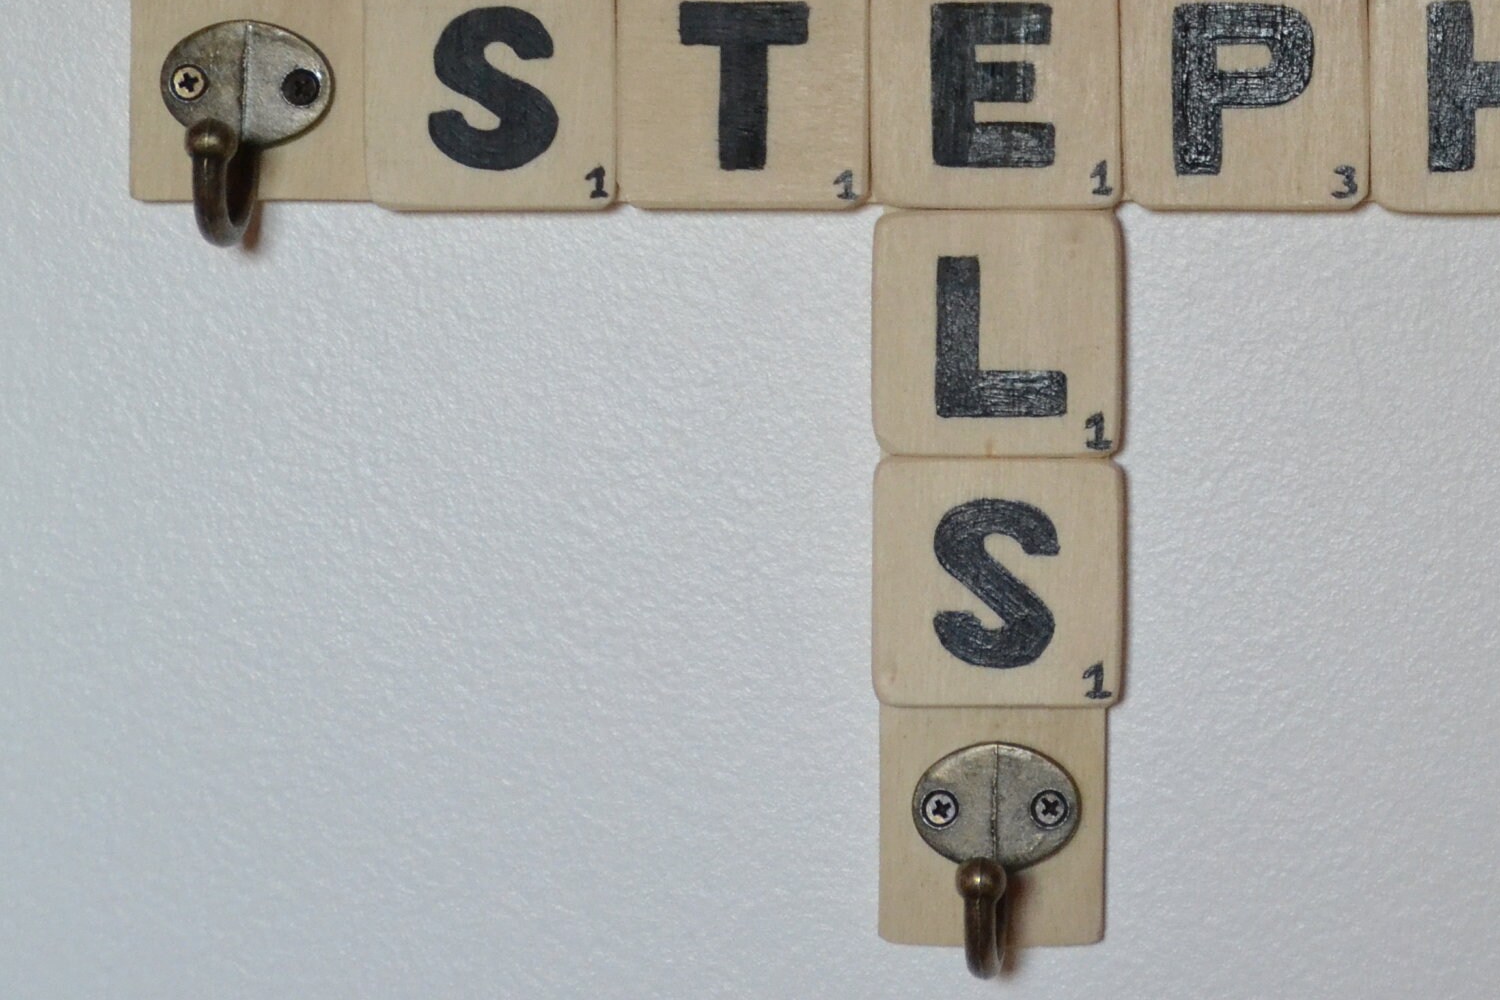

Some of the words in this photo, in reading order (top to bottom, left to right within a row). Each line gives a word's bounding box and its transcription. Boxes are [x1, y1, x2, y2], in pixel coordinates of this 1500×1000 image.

[585, 165, 608, 199] 1
[833, 168, 858, 201] 1
[1090, 160, 1114, 197] 1
[1331, 166, 1359, 200] 3
[1083, 412, 1113, 451] 1
[1081, 662, 1113, 700] 1
